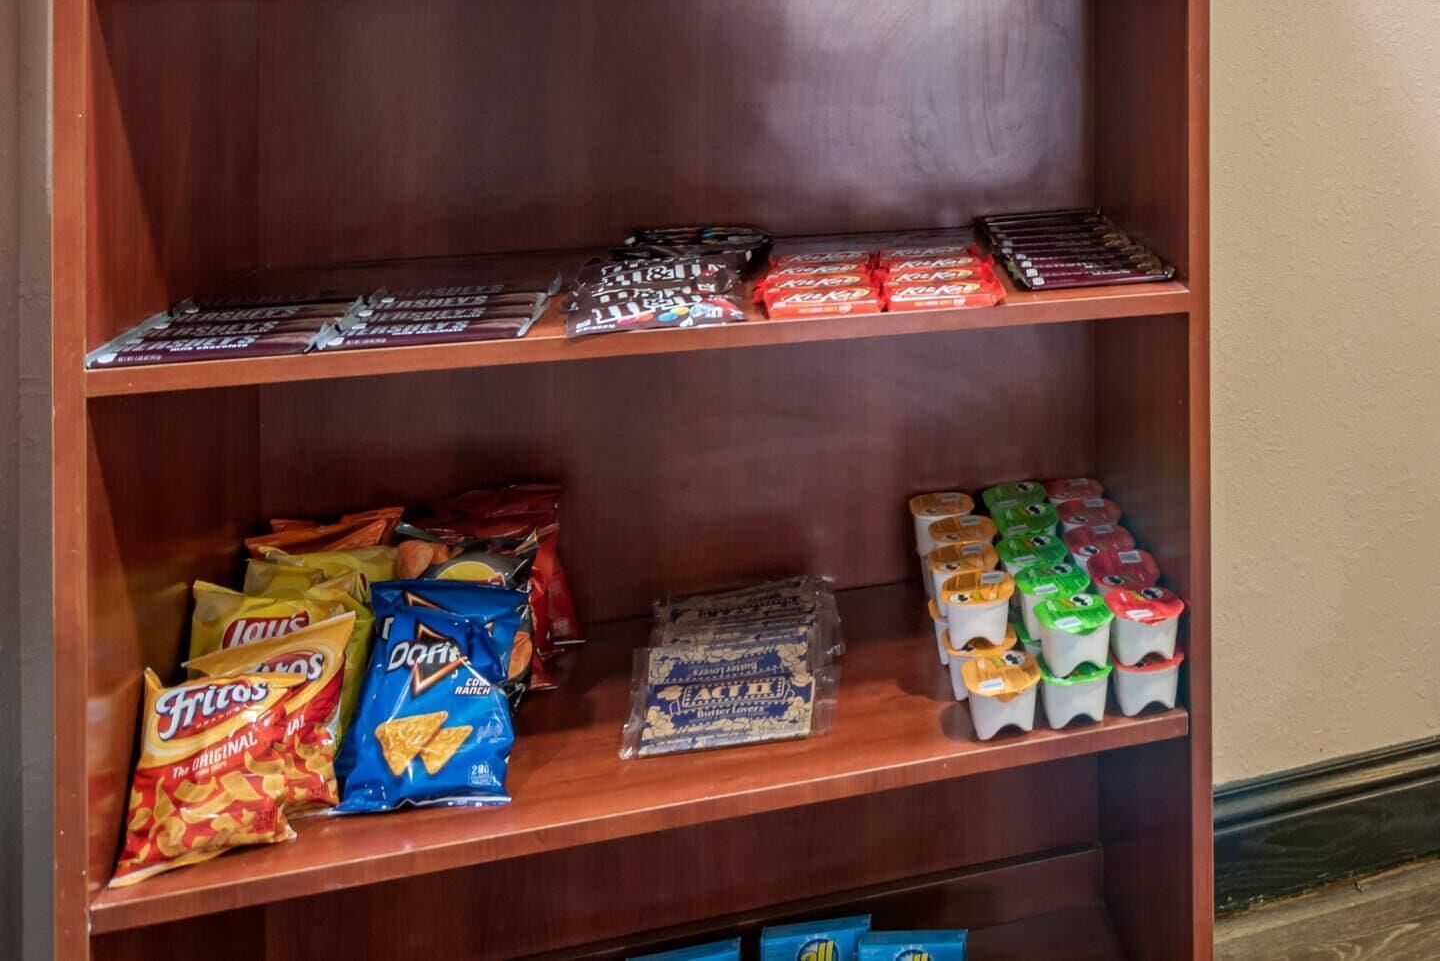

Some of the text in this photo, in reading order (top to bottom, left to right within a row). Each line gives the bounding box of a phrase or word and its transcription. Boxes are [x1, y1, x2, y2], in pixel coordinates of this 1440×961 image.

[454, 686, 491, 696] RANCH
[693, 685, 741, 702] ACT
[156, 682, 268, 741] Fritos
[697, 703, 765, 718] Butter Lovers
[172, 730, 259, 779] The ORIGINAL
